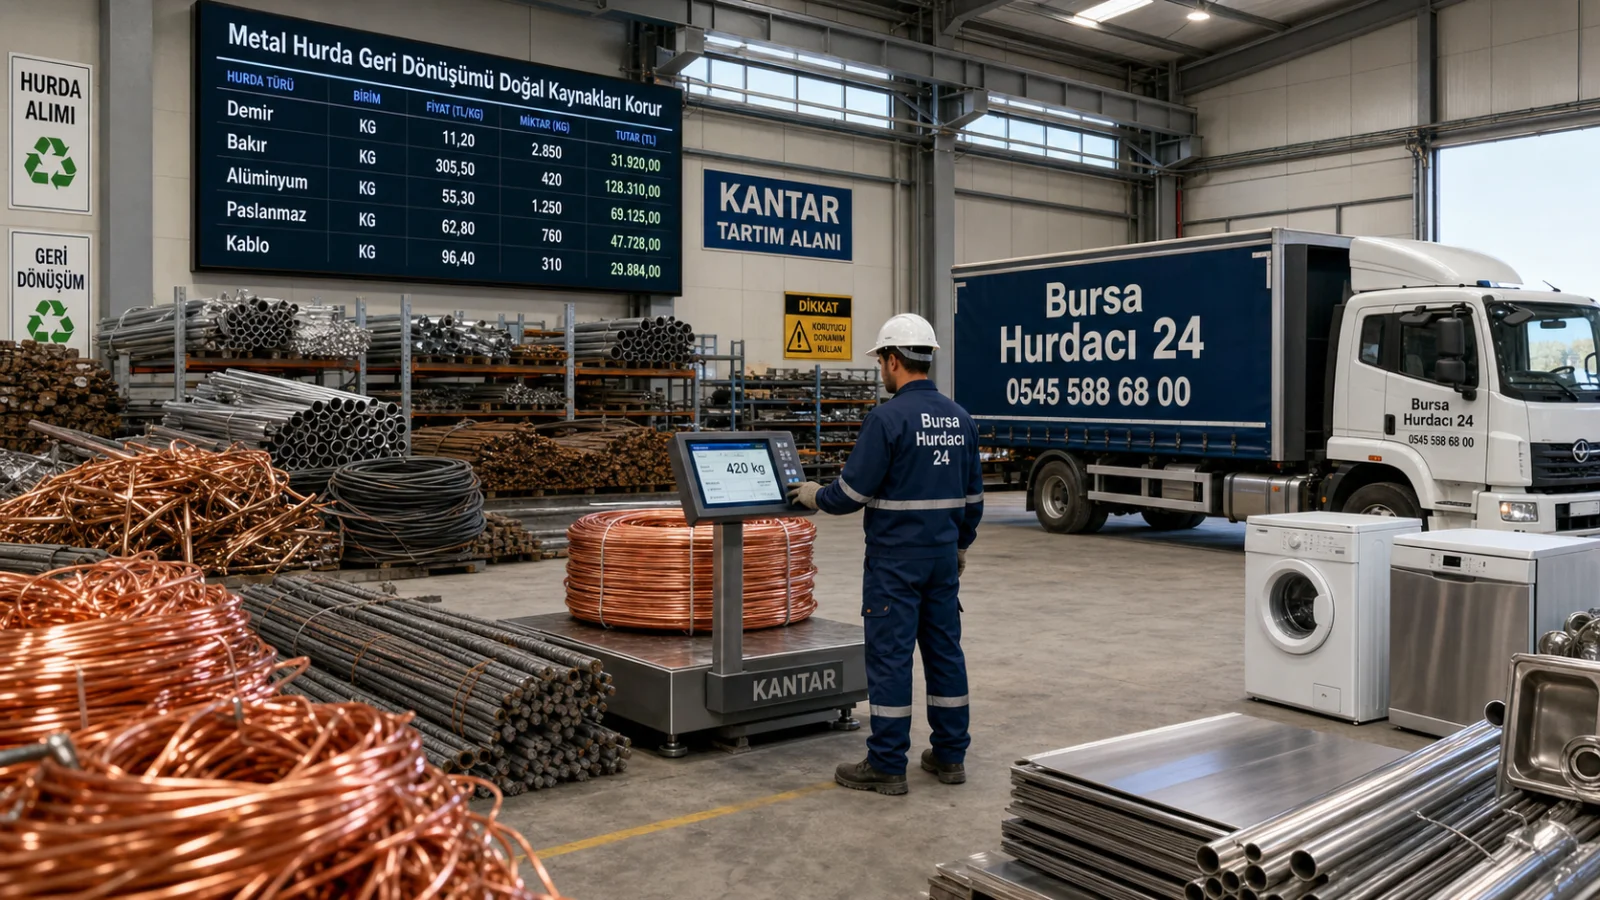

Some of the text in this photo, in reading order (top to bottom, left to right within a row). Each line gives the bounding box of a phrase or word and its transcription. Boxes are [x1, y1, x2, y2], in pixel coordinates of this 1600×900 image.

[228, 22, 662, 117] Metal Hurda Geri Dönüşümü Doğal Kaynakları Korur
[20, 71, 82, 99] HURDA
[25, 100, 75, 125] ALIMI
[227, 70, 657, 147] HURDA TÜRÜ BİRİM FİYAT (TL/KG) MİKTAR (KG) TUTAR (TL)
[227, 100, 661, 172] Demir KG 11,20 2.850 31.920,00
[227, 133, 661, 199] Bakır KG 305,50 420 128.310,00
[226, 167, 661, 225] Alüminyum KG 55,30 1.250 69.125,00
[720, 181, 839, 224] KANTAR
[227, 201, 661, 253] Paslanmaz KG 62,80 760 47.728,00
[717, 221, 841, 251] TARTIM ALANI
[35, 245, 67, 266] GERİ
[226, 234, 661, 279] Kablo KG 96,40 310 29.884,00
[17, 268, 84, 293] DÖNÜŞÜM
[799, 297, 839, 314] DİKKAT
[1046, 282, 1143, 318] Bursa
[817, 344, 843, 353] KULLAN
[1000, 315, 1204, 364] Hurdacı 24
[1006, 376, 1191, 407] 0545 588 68 00
[1411, 398, 1449, 411] Bursa
[921, 413, 960, 428] Bursa
[1403, 413, 1474, 427] Hurdacı 24
[916, 431, 964, 446] Hurdacı
[1408, 434, 1474, 448] 0545 588 68 00
[726, 462, 748, 474] 420
[751, 462, 766, 475] kg
[933, 450, 950, 466] 24
[753, 668, 836, 702] KANTAR
